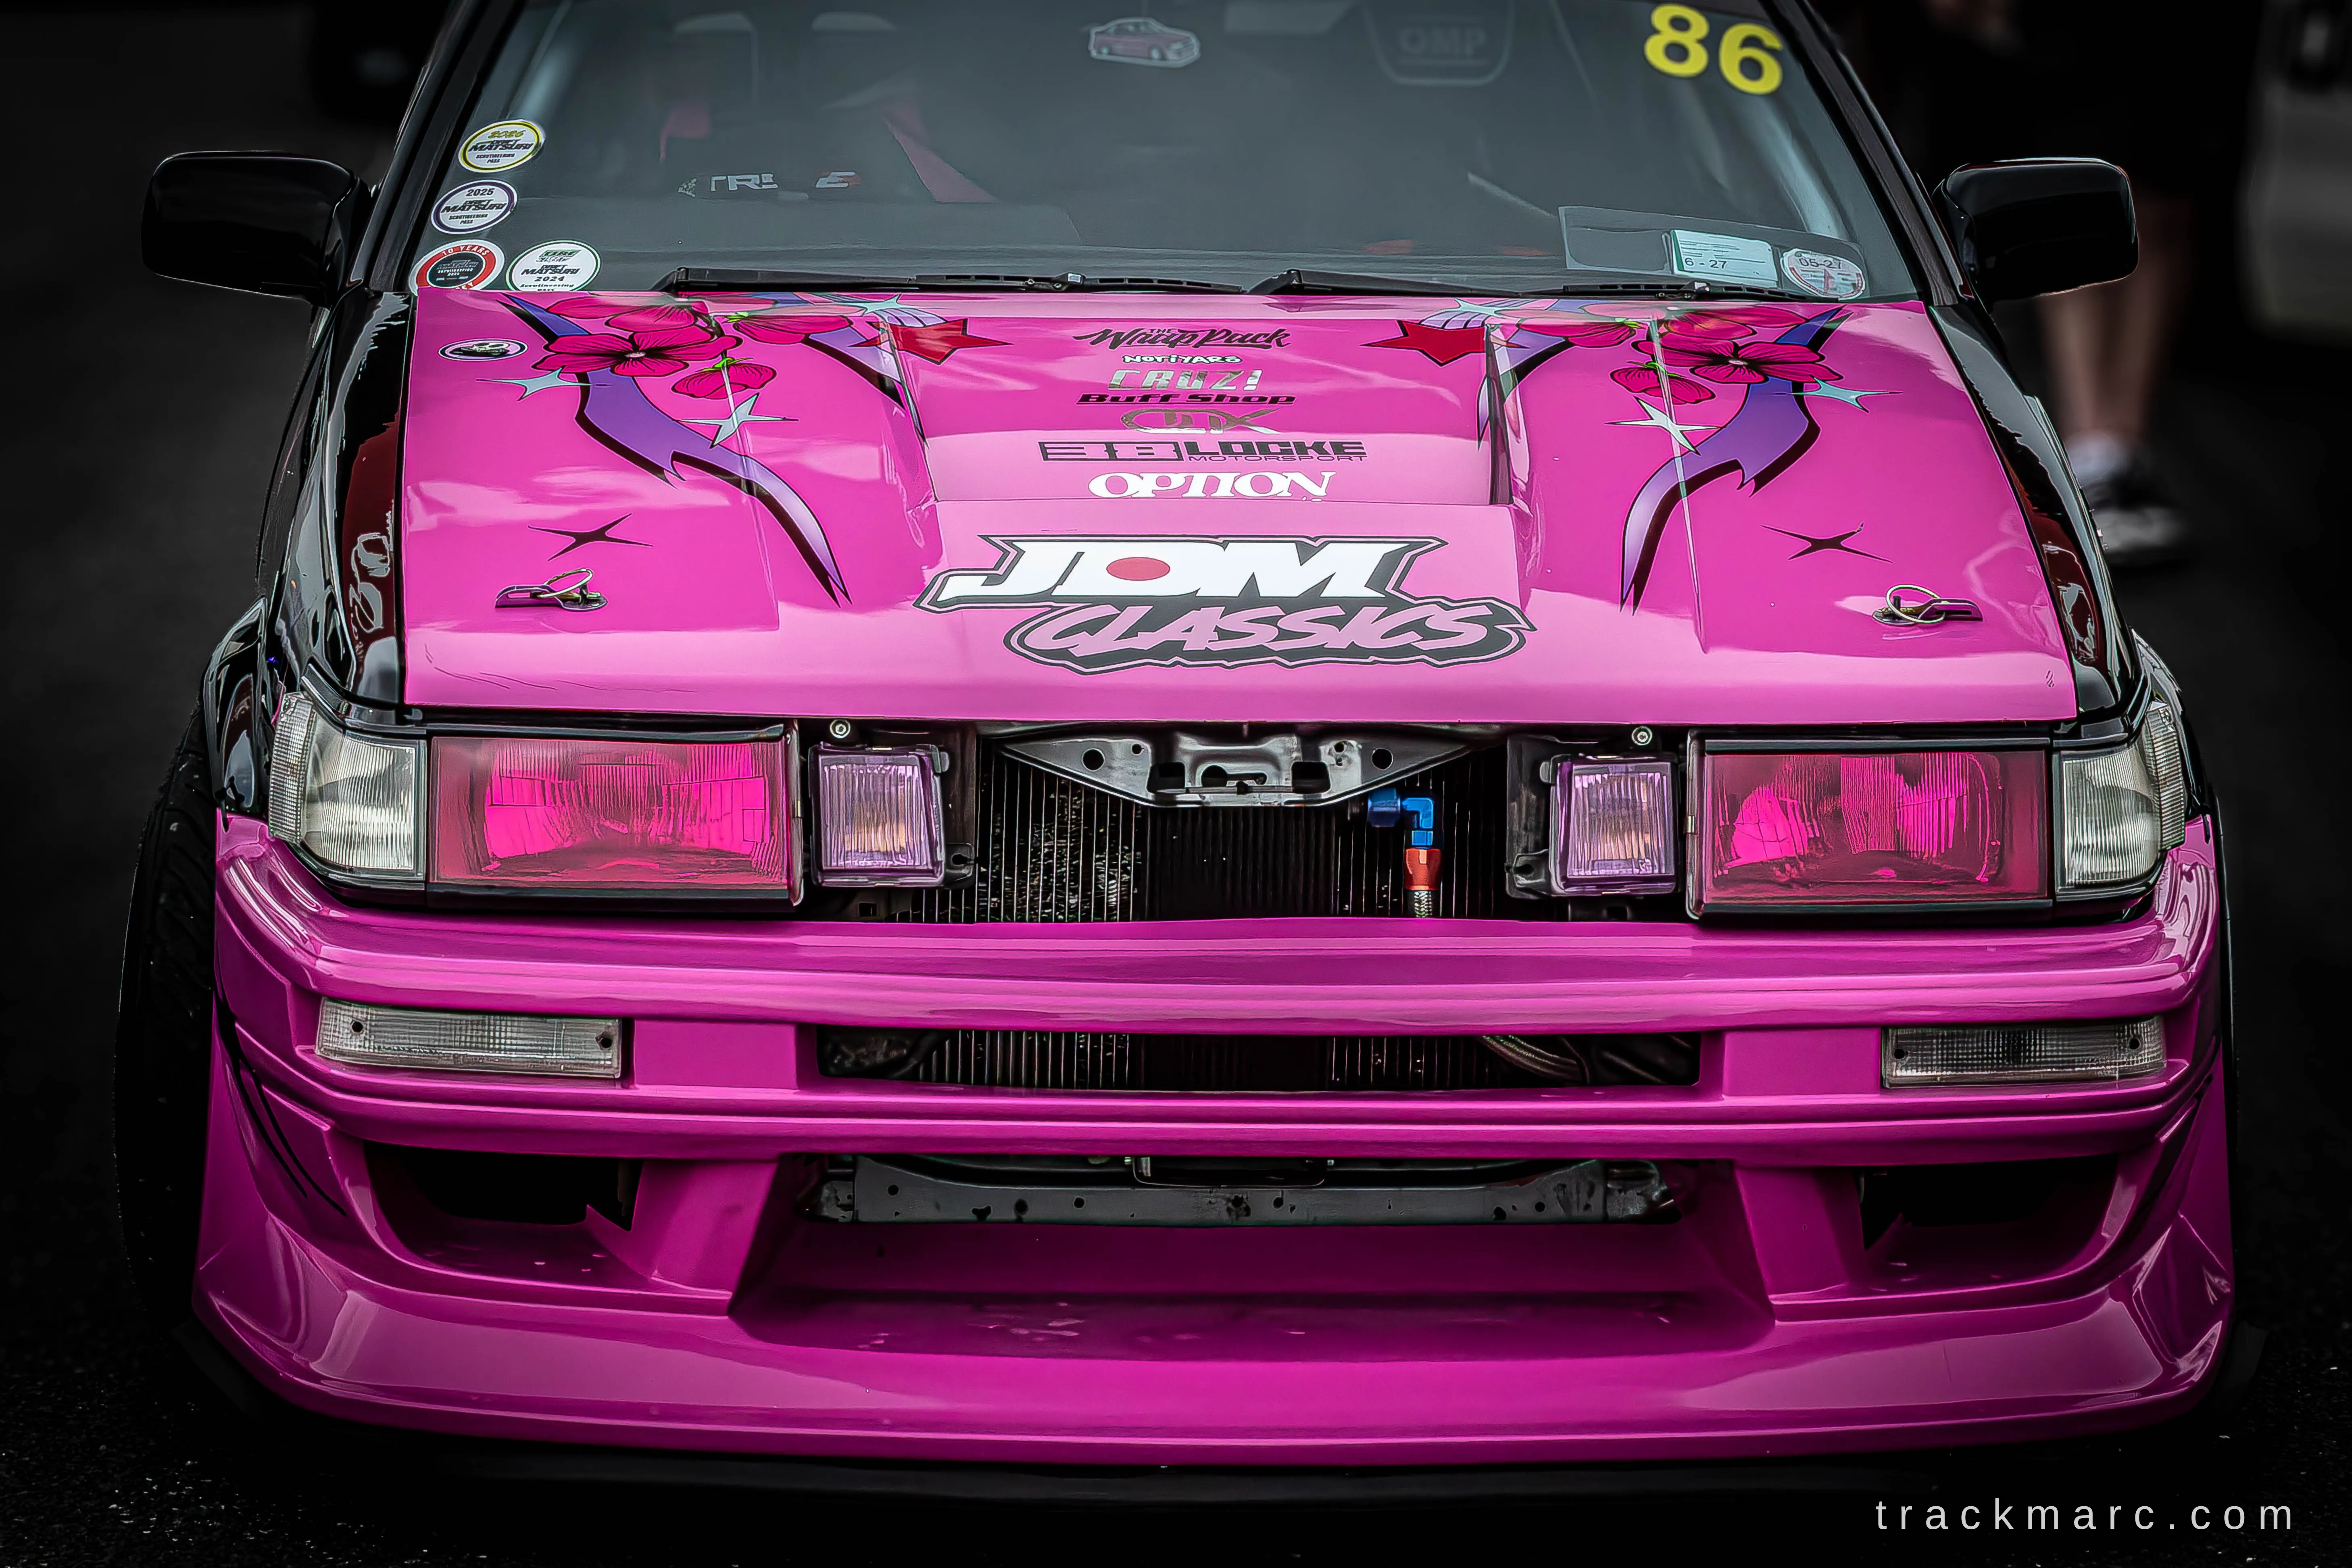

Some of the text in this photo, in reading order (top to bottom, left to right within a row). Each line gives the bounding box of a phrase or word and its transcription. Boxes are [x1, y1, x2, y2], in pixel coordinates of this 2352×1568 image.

[1397, 26, 1487, 56] OMP
[1643, 4, 1783, 95] 86
[466, 188, 495, 196] 2025
[441, 203, 507, 213] MATSURI
[460, 245, 490, 255] YEARS
[1685, 257, 1694, 266] 6
[1709, 259, 1727, 269] 27
[1072, 329, 1292, 350] Wrap Pack
[1078, 394, 1296, 404] Buff Shop
[1183, 442, 1367, 455] LOCKE
[1088, 471, 1337, 498] OPTION
[938, 541, 1410, 598] JDM
[1024, 605, 1491, 657] CLASSICS
